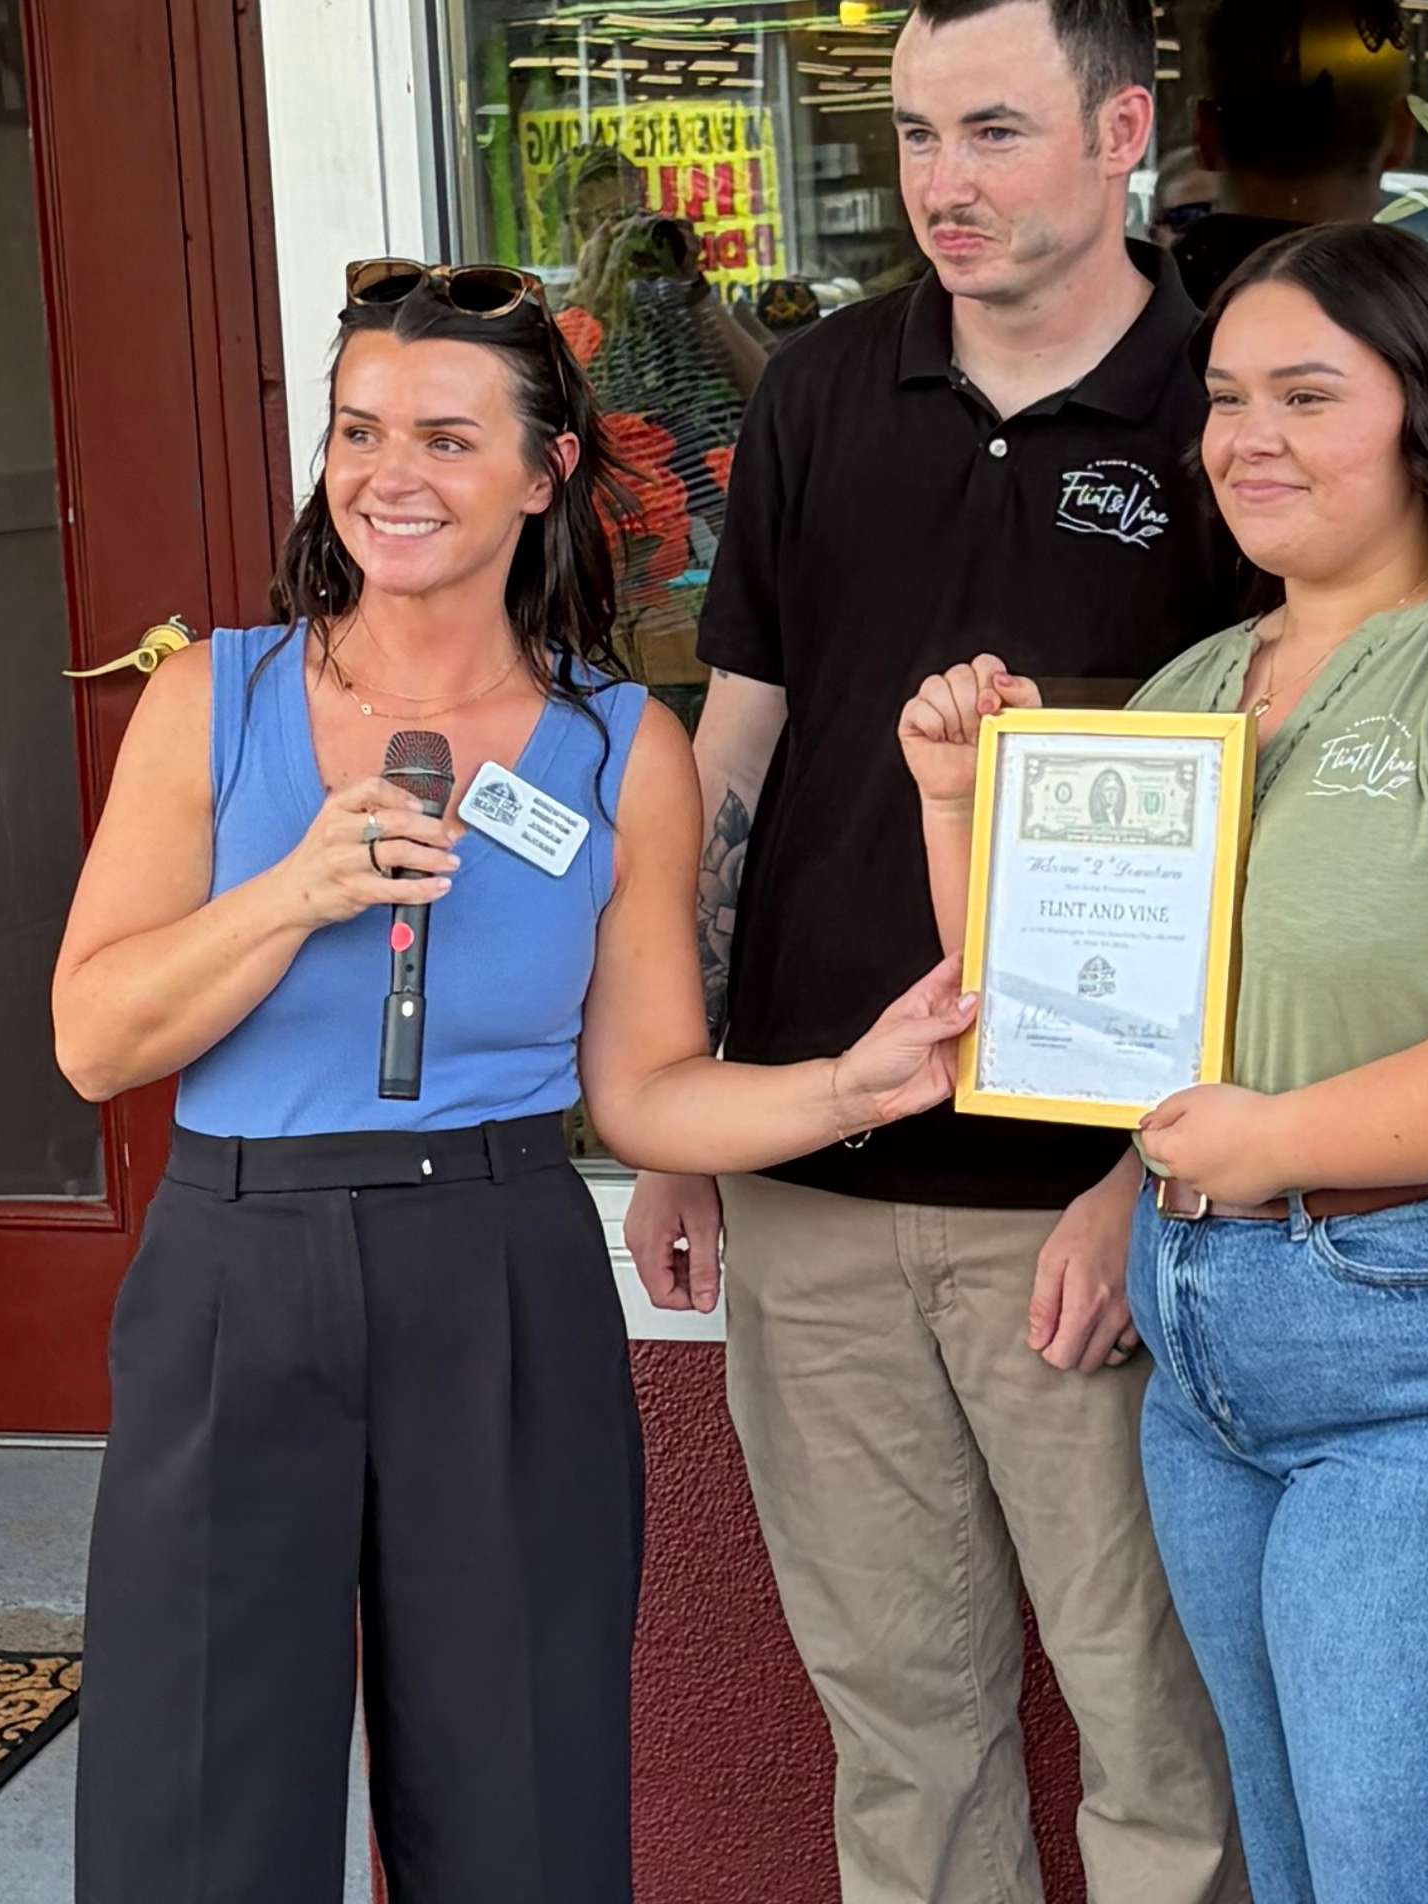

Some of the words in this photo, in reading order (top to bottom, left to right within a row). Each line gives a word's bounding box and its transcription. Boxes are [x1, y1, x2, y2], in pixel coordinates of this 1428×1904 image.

[1060, 472, 1122, 514] Flint
[1119, 482, 1170, 530] Vine
[1367, 735, 1417, 784] Vine
[1039, 899, 1087, 919] FLINT
[1089, 902, 1126, 921] AND
[1129, 904, 1170, 923] VINE
